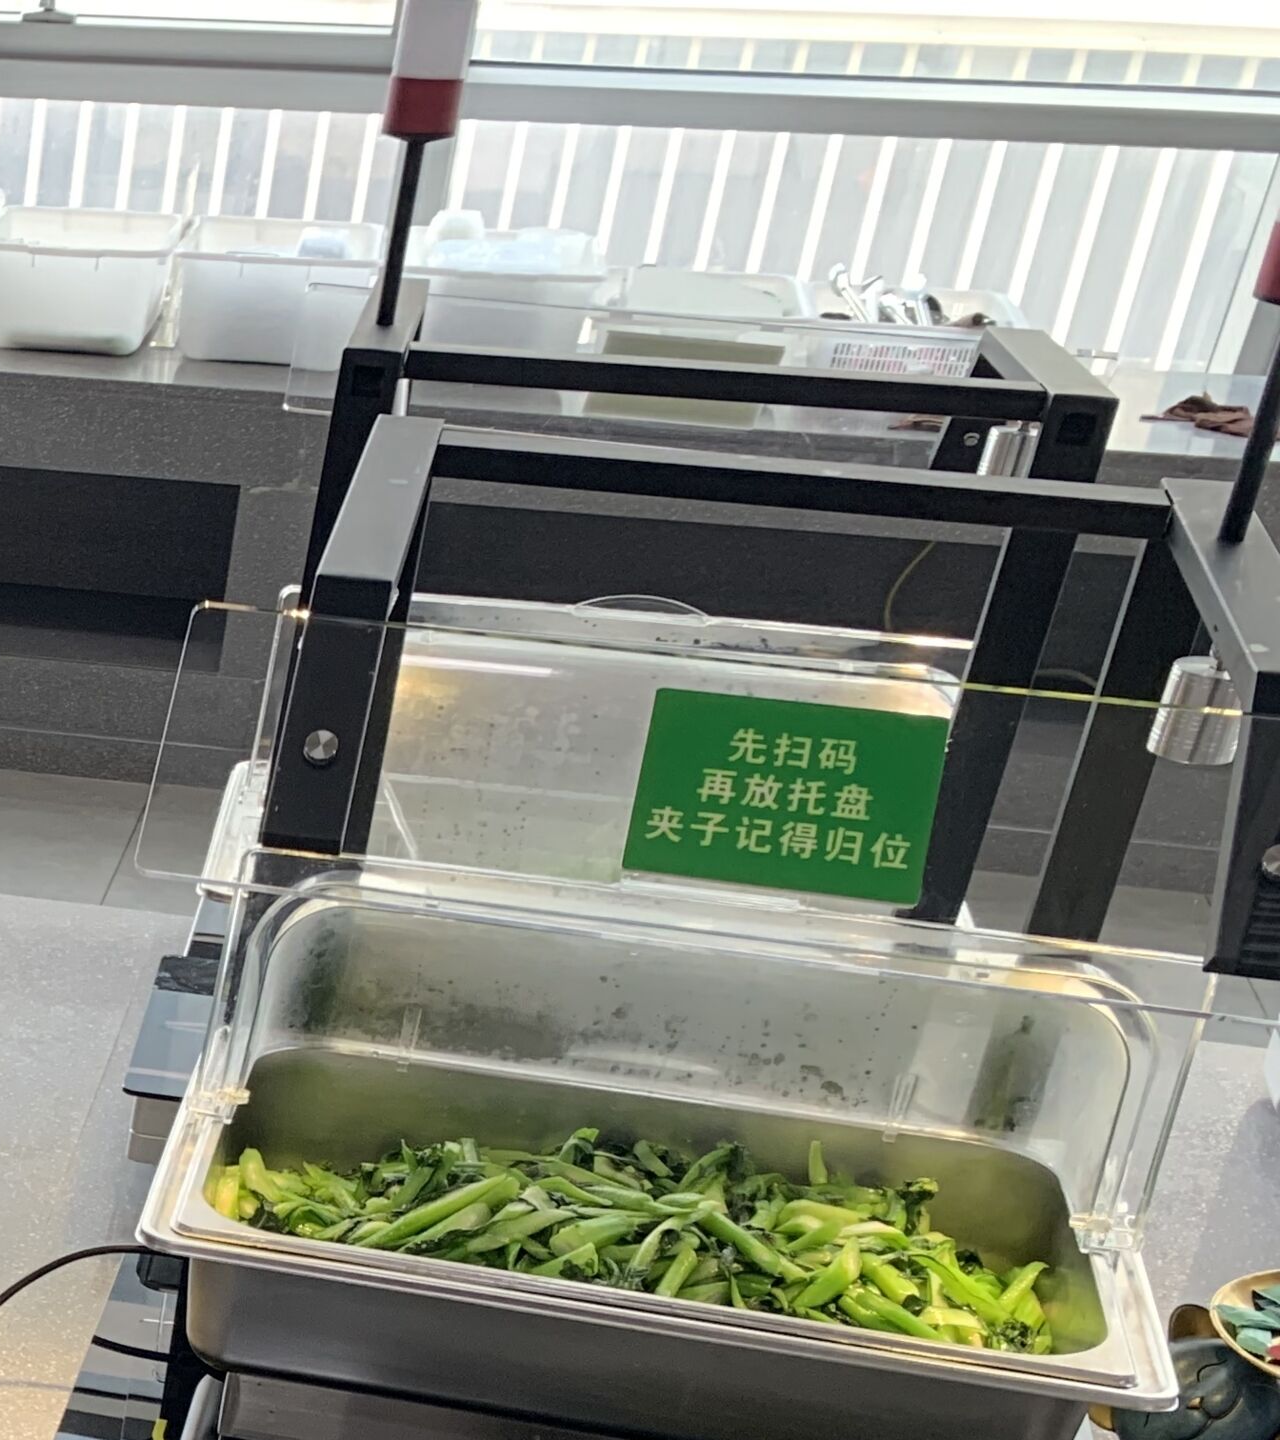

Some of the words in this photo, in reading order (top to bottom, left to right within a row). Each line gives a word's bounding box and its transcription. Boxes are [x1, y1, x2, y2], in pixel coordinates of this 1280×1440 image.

[728, 728, 858, 775] 先扫码
[696, 768, 874, 821] 再放托盘
[645, 805, 912, 869] 夹子记得归位
